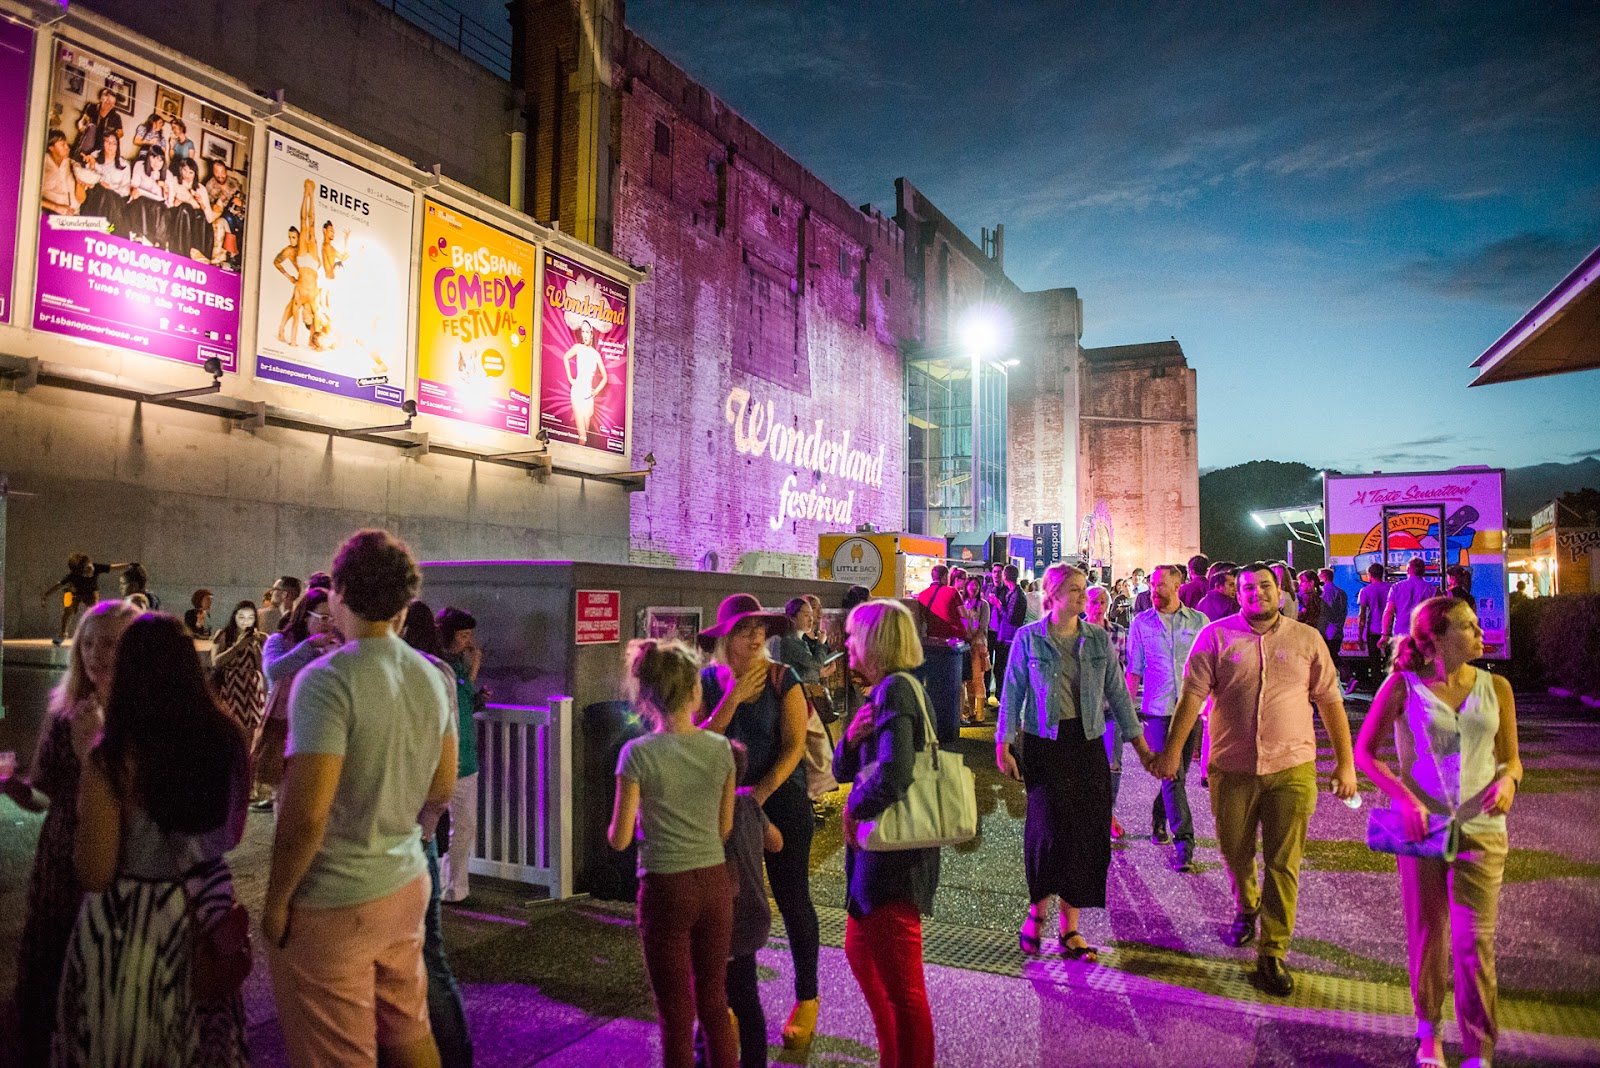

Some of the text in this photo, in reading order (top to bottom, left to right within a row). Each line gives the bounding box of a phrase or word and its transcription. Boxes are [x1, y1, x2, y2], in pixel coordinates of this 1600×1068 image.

[320, 184, 370, 216] BRIEFS
[48, 247, 235, 313] THE KRANSKY SISTERS
[84, 237, 208, 286] TOPOLOGY AND
[451, 245, 523, 278] BRISBANE
[88, 279, 201, 317] Tunes from the Tube
[433, 266, 526, 317] COMEDY
[545, 284, 626, 326] Wonderland
[39, 311, 150, 346] brisbanepowerhouse.org
[442, 309, 518, 344] FESTIVAL
[260, 362, 340, 388] brisbanepowerhouse.org
[726, 388, 885, 488] Wonderland
[770, 474, 853, 531] festival
[1369, 488, 1402, 503] Taste
[1050, 524, 1061, 564] ransport
